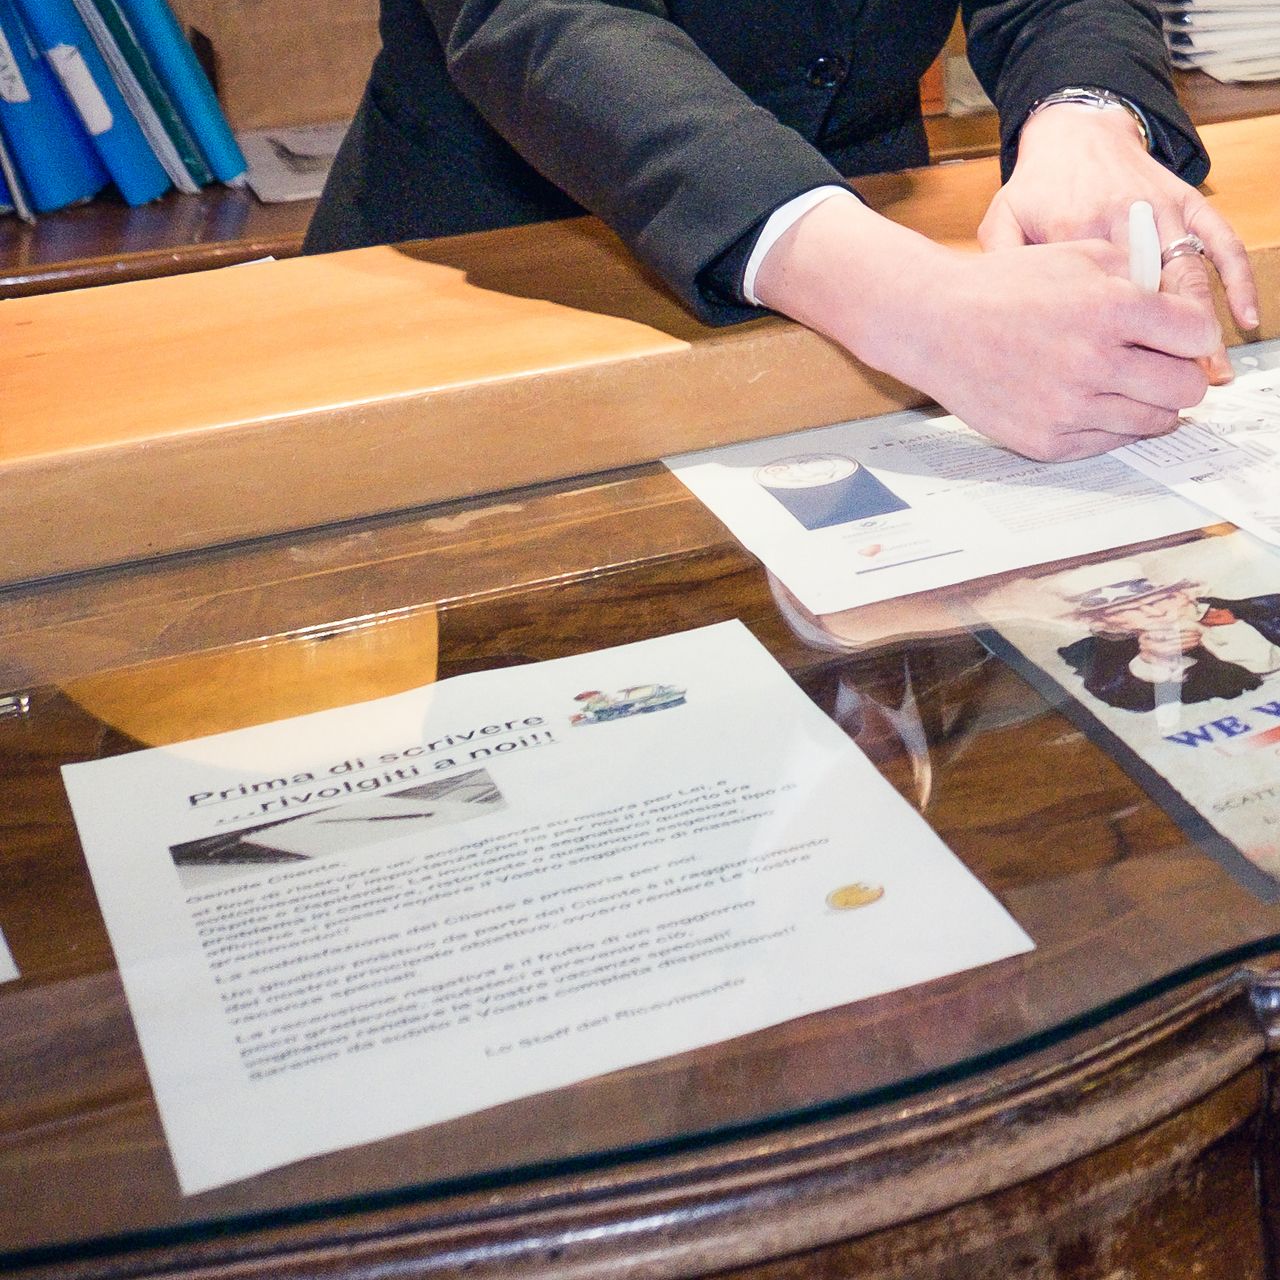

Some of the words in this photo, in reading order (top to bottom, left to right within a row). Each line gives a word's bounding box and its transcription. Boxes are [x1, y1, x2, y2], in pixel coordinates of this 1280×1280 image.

[433, 758, 457, 771] a
[469, 731, 555, 760] noi!!
[1163, 715, 1252, 748] WE
[188, 770, 315, 808] Prima
[327, 757, 366, 776] di
[378, 716, 546, 762] scrivere
